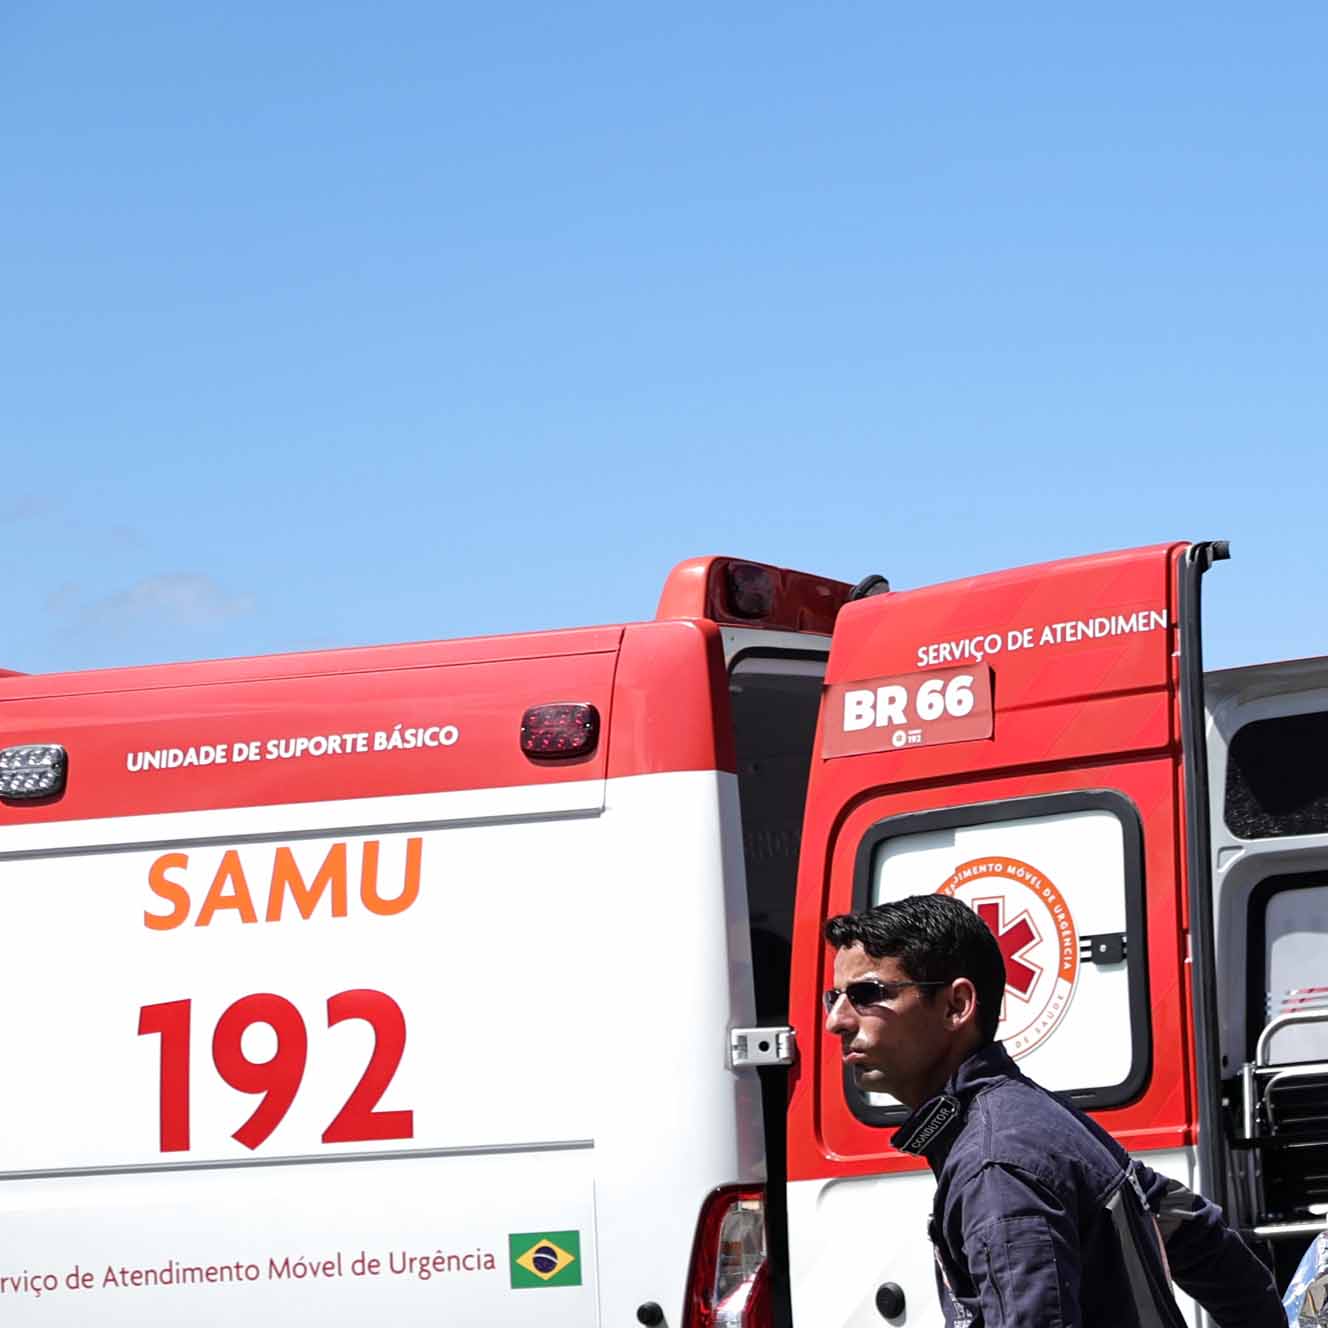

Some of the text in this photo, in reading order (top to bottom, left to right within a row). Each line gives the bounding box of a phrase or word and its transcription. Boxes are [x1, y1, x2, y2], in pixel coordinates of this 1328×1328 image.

[917, 634, 1001, 667] SERVIÇO
[1007, 628, 1034, 651] DE
[843, 675, 974, 732] BR 66
[126, 724, 459, 772] UNIDADE DE SUPORTE BÁSICO
[143, 837, 424, 932] SAMU
[1007, 865, 1042, 889] MÓVEL
[1054, 904, 1073, 970] URGÊNCIA
[137, 988, 414, 1152] 192
[911, 1107, 951, 1149] CONDUTOR
[66, 1265, 94, 1290] de
[102, 1261, 260, 1289] Atendimento
[267, 1252, 343, 1280] Móvel
[351, 1251, 381, 1276] de
[390, 1247, 497, 1282] Urgência
